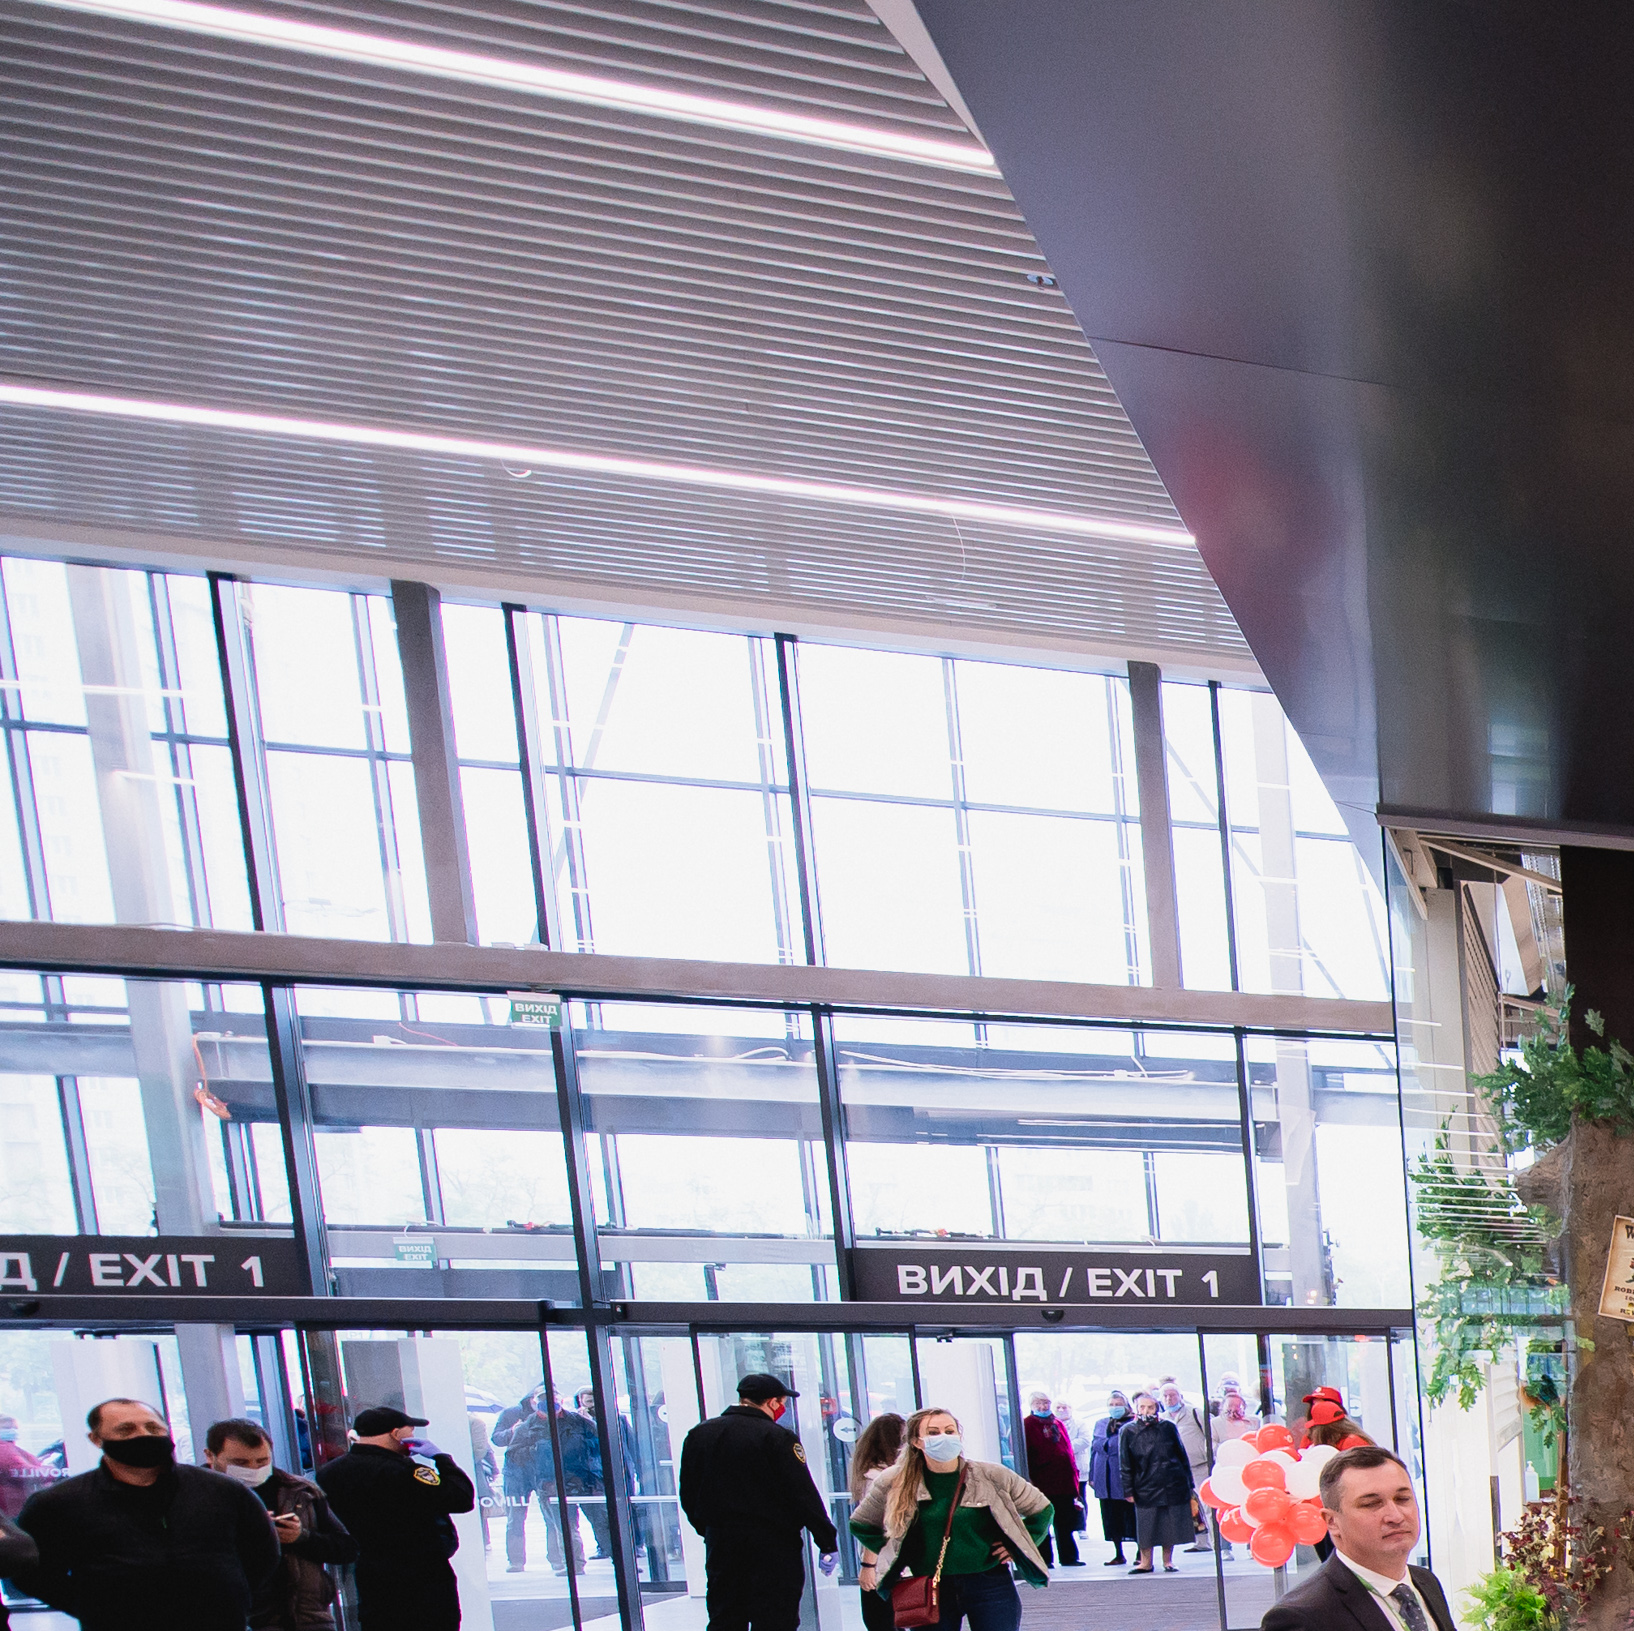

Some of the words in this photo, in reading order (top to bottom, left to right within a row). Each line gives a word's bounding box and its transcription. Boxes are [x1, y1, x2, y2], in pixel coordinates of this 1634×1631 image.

[514, 1003, 558, 1015] ВИХІД
[522, 1014, 552, 1024] EXIT
[88, 1253, 216, 1287] EXIT
[241, 1256, 265, 1288] 1
[897, 1265, 1048, 1301] ВИХІД
[1087, 1268, 1183, 1298] EXIT
[1201, 1270, 1220, 1298] 1
